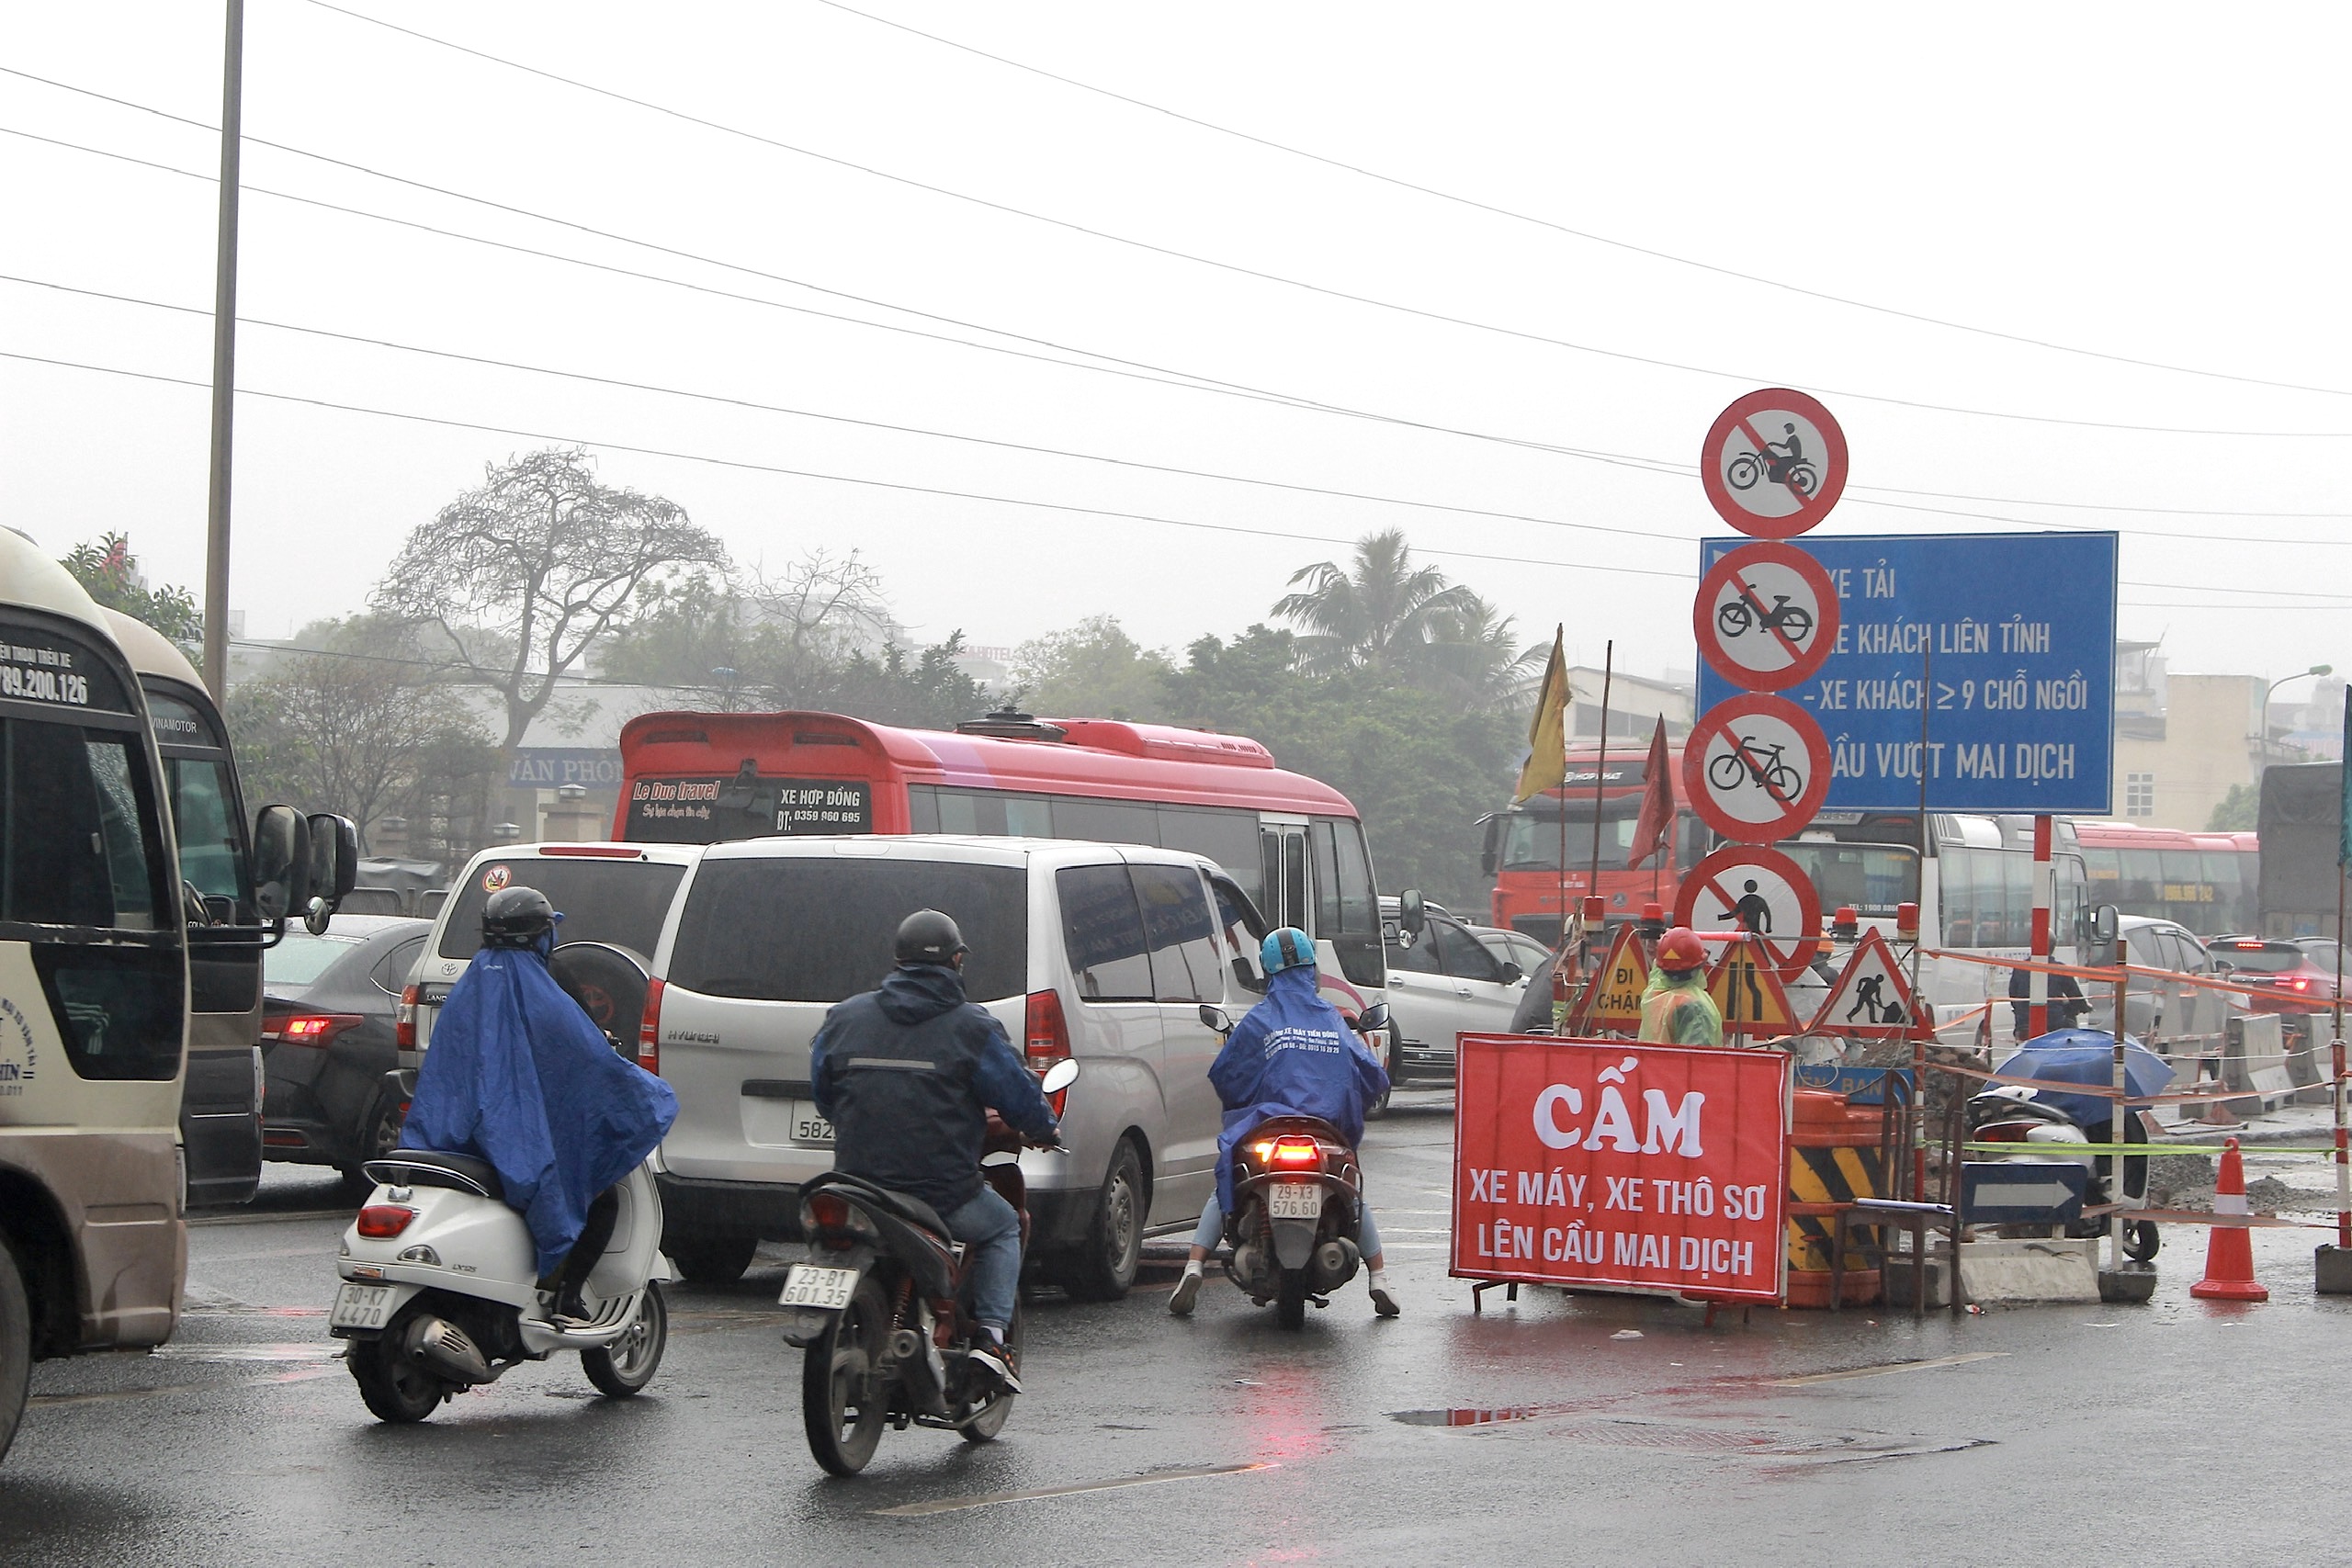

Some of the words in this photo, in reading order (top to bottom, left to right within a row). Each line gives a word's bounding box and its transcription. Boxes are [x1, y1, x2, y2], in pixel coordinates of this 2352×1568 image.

[1862, 558, 1895, 598] TẢI
[1830, 624, 1849, 654] E
[1858, 616, 1930, 654] KHÁCH
[1940, 617, 1988, 653] LIÊN
[1999, 614, 2049, 653] TỈNH
[59, 651, 72, 669] XE
[0, 665, 88, 705] 89.200.126
[1856, 671, 1929, 710] KHÁCH
[1962, 680, 1974, 710] 9
[1984, 669, 2028, 710] CHỖ
[2035, 671, 2087, 710] NGỒI
[150, 716, 197, 733] VINAMOTOR
[510, 753, 555, 781] VĂN
[1829, 732, 1866, 779] ẦU
[1876, 740, 1945, 784] VƯỢT
[1956, 743, 2005, 779] MAI
[2016, 743, 2075, 786] DỊCH
[633, 783, 650, 800] Le
[650, 782, 677, 800] Duc
[677, 780, 720, 800] travel
[781, 789, 797, 805] XE
[799, 789, 824, 808] HỢP
[826, 785, 860, 807] ĐỒNG
[794, 810, 819, 821] 0359
[821, 811, 839, 822] 960
[842, 812, 860, 823] 695
[1849, 904, 1862, 912] TEL:
[1617, 968, 1633, 985] ĐI
[669, 1031, 720, 1044] HYUNDAI
[1533, 1056, 1705, 1158] CẤM
[1277, 1185, 1313, 1200] 29-X3
[1470, 1168, 1507, 1203] XE
[1518, 1167, 1594, 1213] MÁY,
[1605, 1177, 1643, 1212] XE
[1653, 1176, 1714, 1217] THÔ
[1724, 1184, 1767, 1221] SƠ
[1273, 1201, 1317, 1215] 576.60
[1478, 1218, 1532, 1259] LÊN
[1543, 1219, 1604, 1264] CẦU
[1614, 1232, 1669, 1269] MAI
[1679, 1236, 1753, 1280] DỊCH
[797, 1268, 846, 1288] 23-B1
[345, 1287, 388, 1306] 30-K7
[786, 1286, 847, 1305] 601.35
[339, 1306, 381, 1325] 4470
